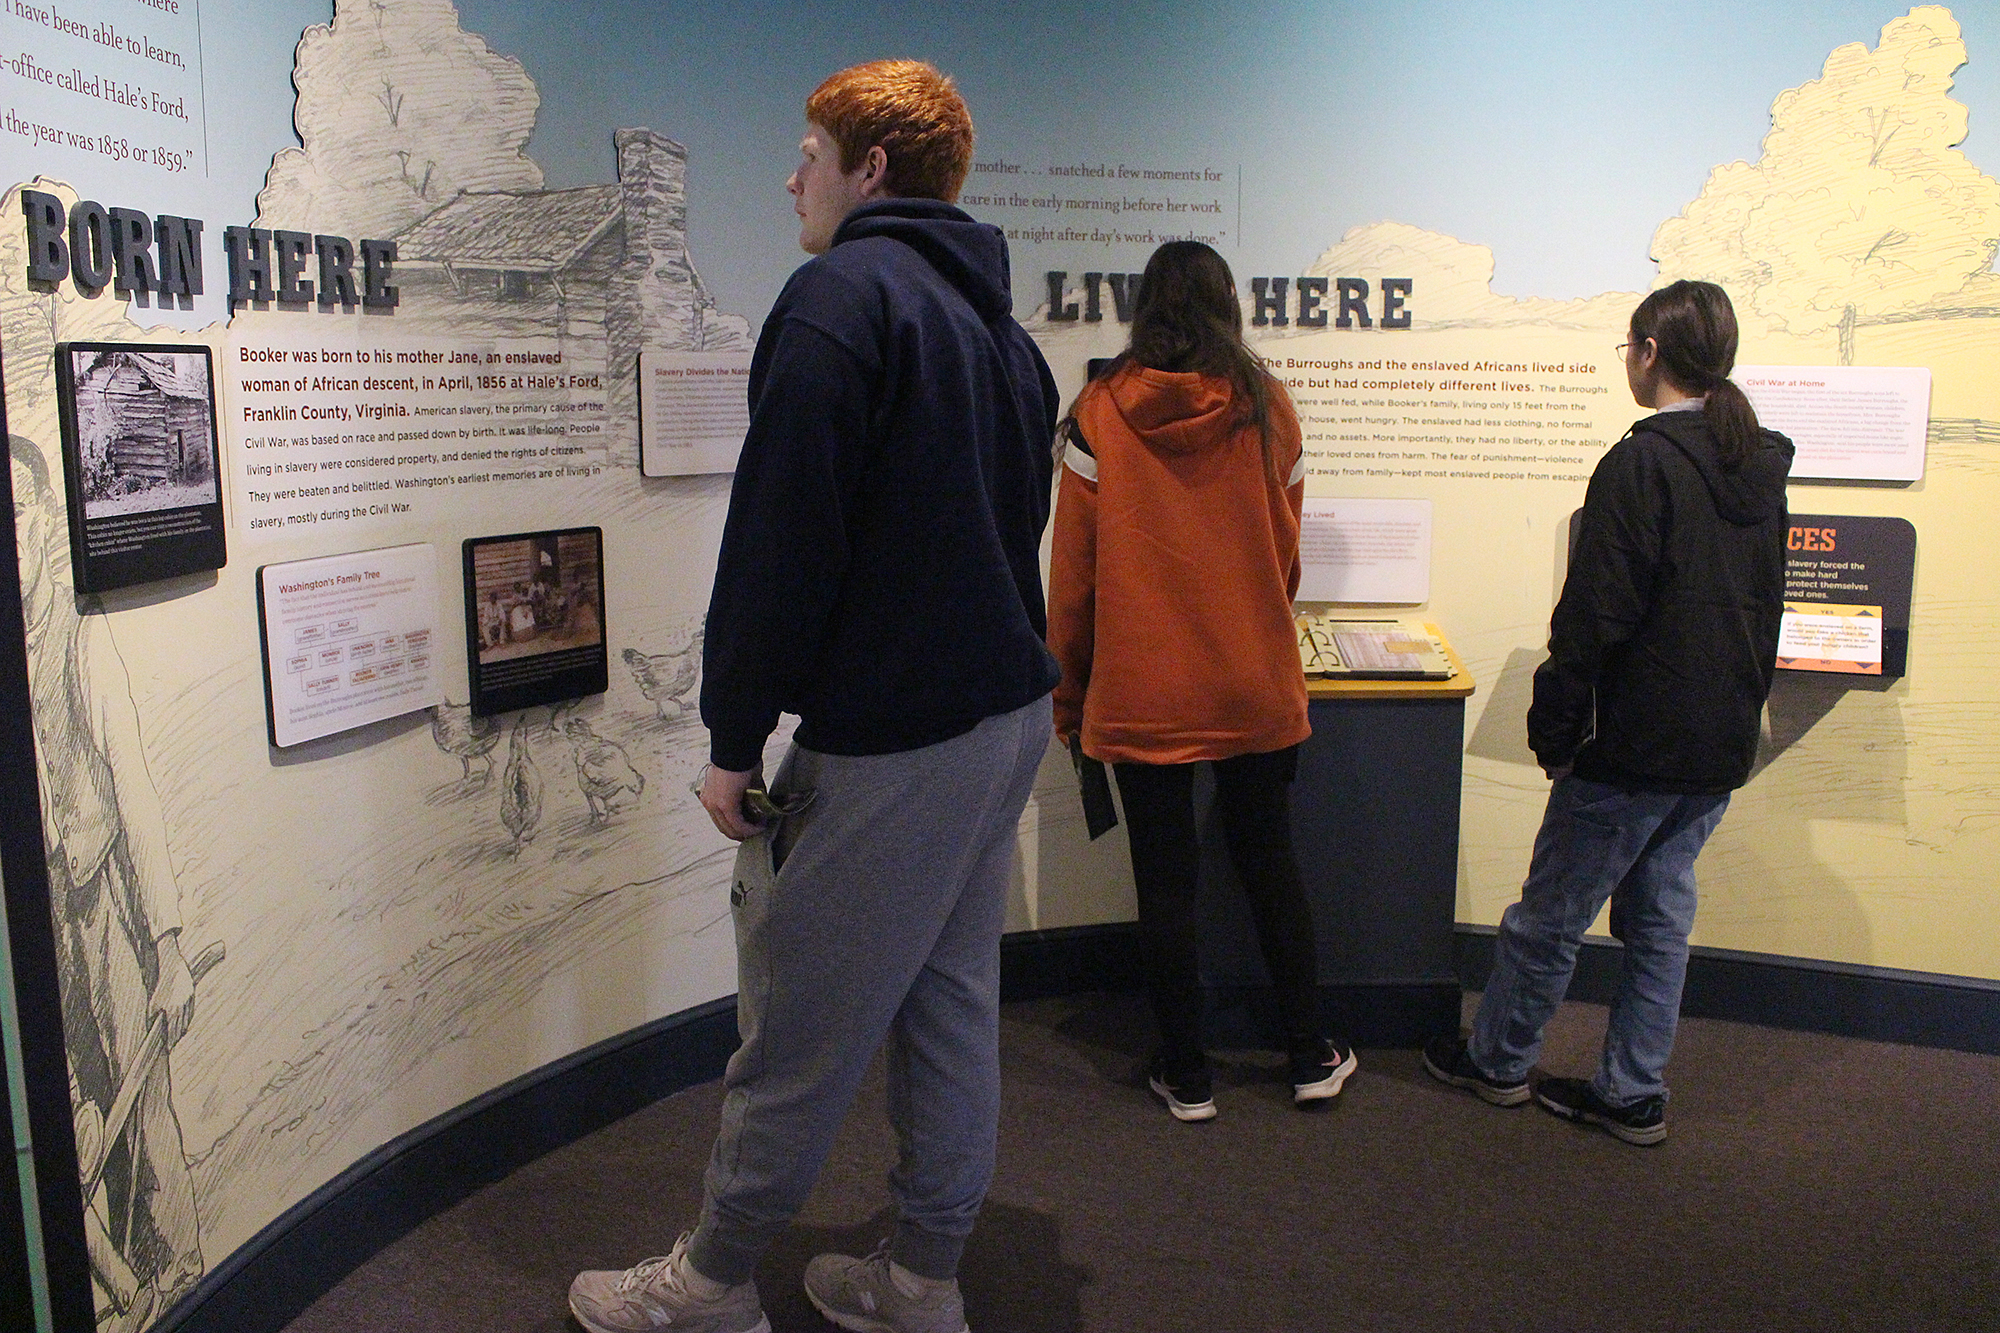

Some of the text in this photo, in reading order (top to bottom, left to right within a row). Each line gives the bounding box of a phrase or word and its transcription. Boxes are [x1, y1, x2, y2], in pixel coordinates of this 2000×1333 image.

[15, 0, 49, 26] have
[52, 5, 90, 40] been
[93, 22, 123, 50] able
[126, 35, 141, 55] to
[144, 36, 186, 71] learn,
[57, 69, 100, 98] called
[103, 79, 148, 110] Hale's
[151, 92, 189, 123] Ford,
[6, 108, 30, 136] the
[32, 123, 63, 147] year
[66, 132, 94, 151] was
[98, 135, 128, 161] 1858
[133, 147, 148, 162] or
[975, 161, 1222, 181] mother snatched a few moments for
[963, 194, 989, 206] care
[994, 193, 1006, 206] in
[1009, 194, 1029, 206] the
[1032, 197, 1063, 213] early
[1066, 197, 1119, 213] morning
[1123, 200, 1163, 212] before
[1167, 200, 1186, 213] her
[1191, 200, 1221, 213] work
[1008, 230, 1018, 239] at
[1022, 228, 1054, 244] night
[1057, 229, 1088, 241] after
[1091, 228, 1121, 245] day's
[1125, 230, 1155, 243] work
[1158, 233, 1182, 243] was
[21, 190, 400, 315] BORN HERE
[1047, 271, 1413, 329] LIV HERE
[240, 347, 561, 365] Booker was born to his mother Jane, an enslaved
[1287, 358, 1353, 371] Burroughs
[1358, 360, 1381, 370] and
[1386, 360, 1407, 370] the
[1412, 361, 1468, 371] enslaved
[1474, 362, 1528, 372] Africans
[1532, 362, 1564, 373] lived
[1569, 363, 1597, 373] side
[655, 368, 683, 377] Slavery
[686, 368, 714, 376] Divides
[241, 375, 602, 392] woman of African descent, in April, 1856 at Hale's Ford,
[1308, 378, 1330, 388] but
[1334, 379, 1358, 388] had
[1362, 379, 1435, 392] completely
[1439, 381, 1497, 391] different
[1501, 381, 1535, 392] lives.
[1539, 384, 1556, 393] The
[1559, 385, 1608, 395] Burroughs
[244, 402, 604, 422] Franklin County, Virginia. American slavery, the primary cause of the
[1341, 399, 1358, 407] fed,
[1388, 400, 1427, 408] Booker's
[1430, 400, 1460, 409] family,
[1462, 401, 1487, 410] living
[1490, 402, 1510, 411] only
[1525, 402, 1543, 410] feet
[1546, 402, 1568, 410] from
[1571, 403, 1586, 411] the
[245, 437, 264, 449] Civil
[268, 437, 289, 448] War,
[291, 437, 309, 446] was
[311, 434, 339, 445] based
[342, 435, 352, 443] on
[356, 433, 375, 443] race
[378, 431, 395, 441] and
[397, 430, 429, 442] passed
[431, 430, 456, 439] down
[459, 428, 470, 439] by
[472, 427, 496, 437] birth.
[508, 427, 525, 436] was
[527, 425, 567, 436] life-long.
[570, 424, 600, 434] People
[246, 465, 272, 476] living
[274, 463, 282, 474] in
[285, 461, 317, 473] slavery
[320, 460, 342, 470] were
[345, 455, 395, 468] considered
[398, 453, 440, 466] property,
[442, 452, 458, 462] and
[461, 450, 492, 461] denied
[494, 450, 509, 458] the
[511, 448, 537, 459] rights
[539, 447, 549, 456] of
[250, 503, 412, 529] slavery, mostly during the Civil War.
[1788, 560, 1818, 569] slavery
[1820, 561, 1848, 569] forced
[279, 571, 380, 594] Washington's Family Tree
[1820, 582, 1868, 590] themselves
[1806, 591, 1829, 599] ones.
